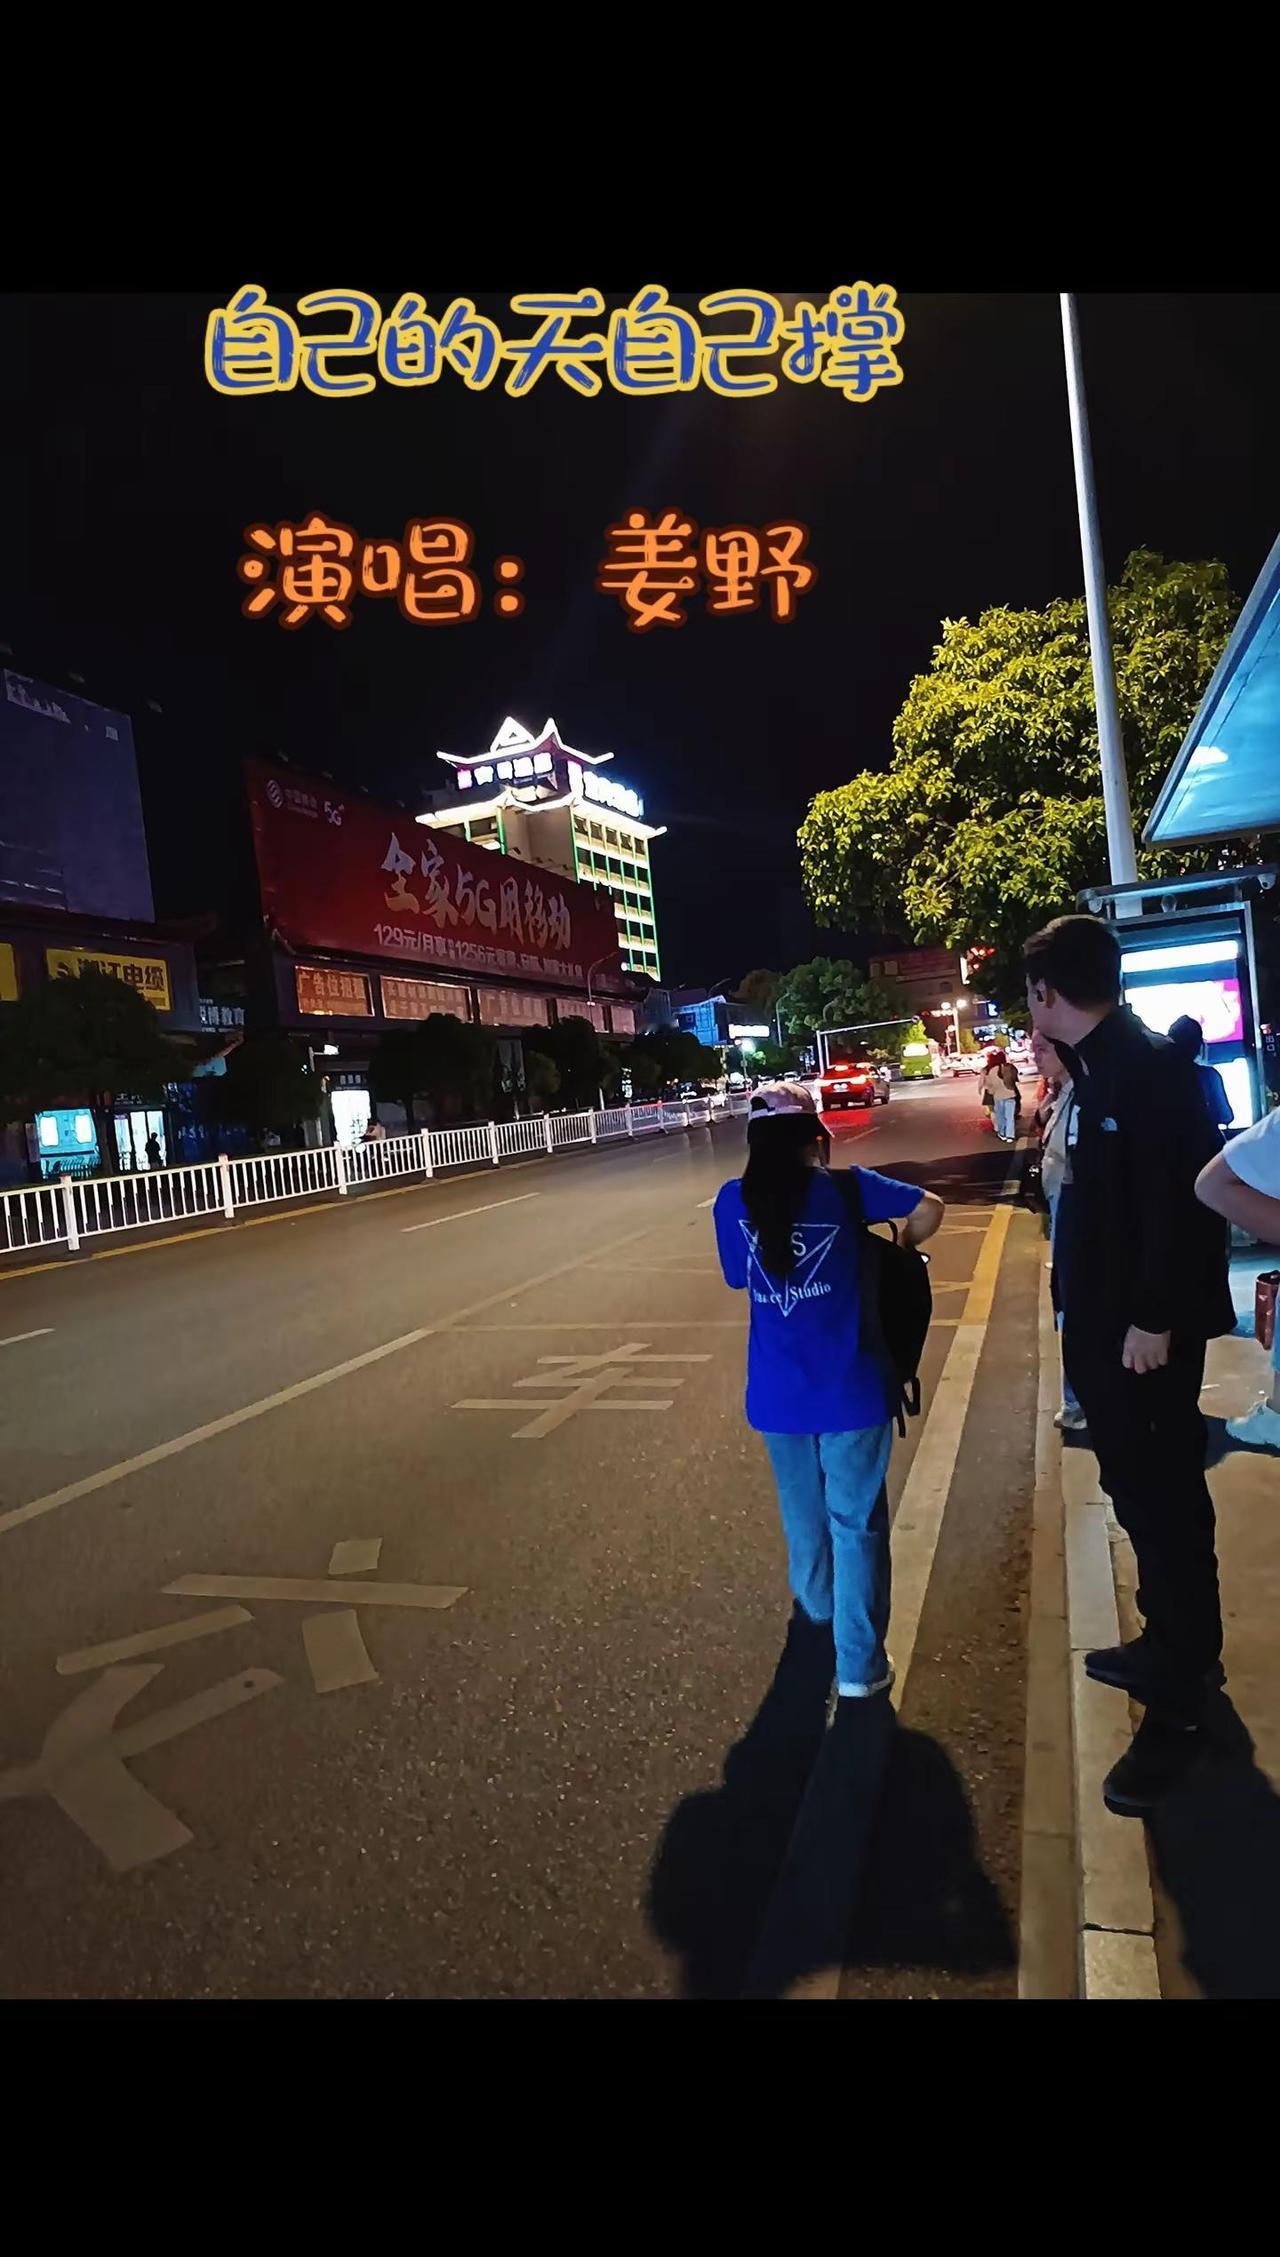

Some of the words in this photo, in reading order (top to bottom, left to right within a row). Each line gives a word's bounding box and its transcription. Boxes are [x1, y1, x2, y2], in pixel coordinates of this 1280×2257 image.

[381, 833, 571, 951] 全家5G用移动
[789, 1281, 831, 1303] Studio
